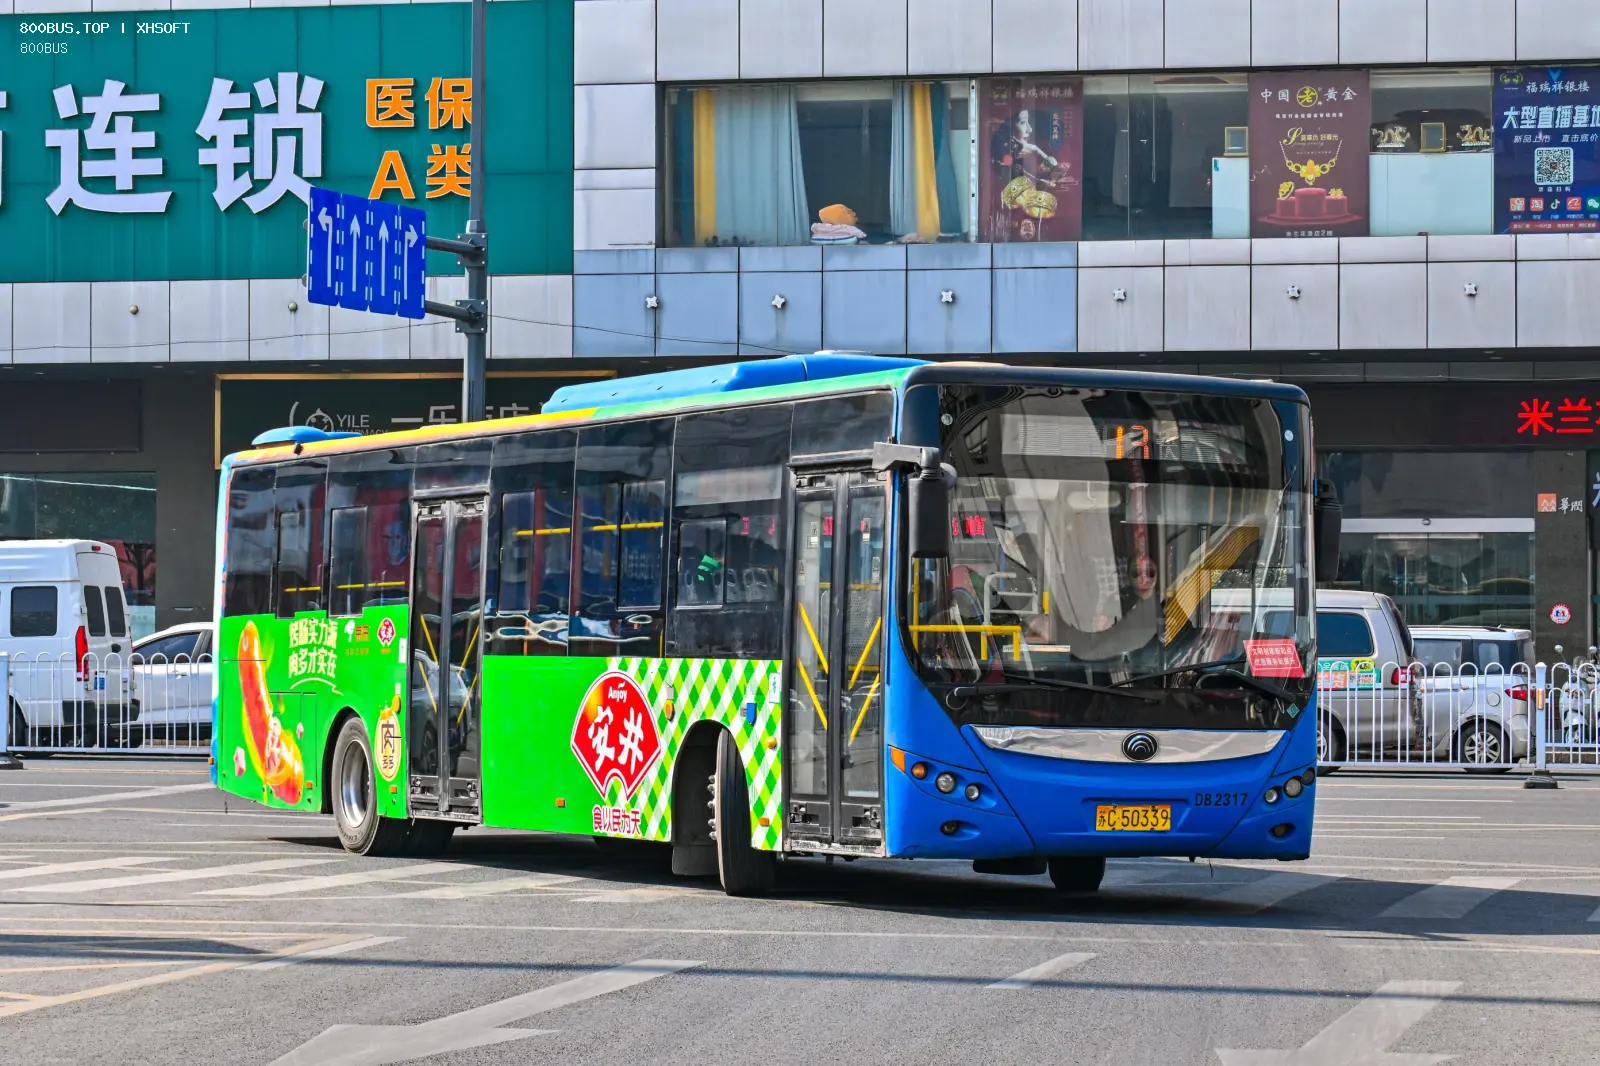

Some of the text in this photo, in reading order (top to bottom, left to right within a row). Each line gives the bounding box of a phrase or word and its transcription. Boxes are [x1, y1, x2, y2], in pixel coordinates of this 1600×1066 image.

[365, 77, 471, 130] 医保
[1503, 104, 1600, 129] 大型直播基地
[0, 72, 324, 216] 连锁
[1513, 133, 1598, 144] 新品上市 直击底价
[368, 143, 471, 199] A类
[336, 414, 370, 428] YILE
[1517, 398, 1600, 436] 米兰
[608, 681, 628, 702] Anjoy
[588, 705, 644, 775] 安井
[592, 806, 641, 835] 食以民为天
